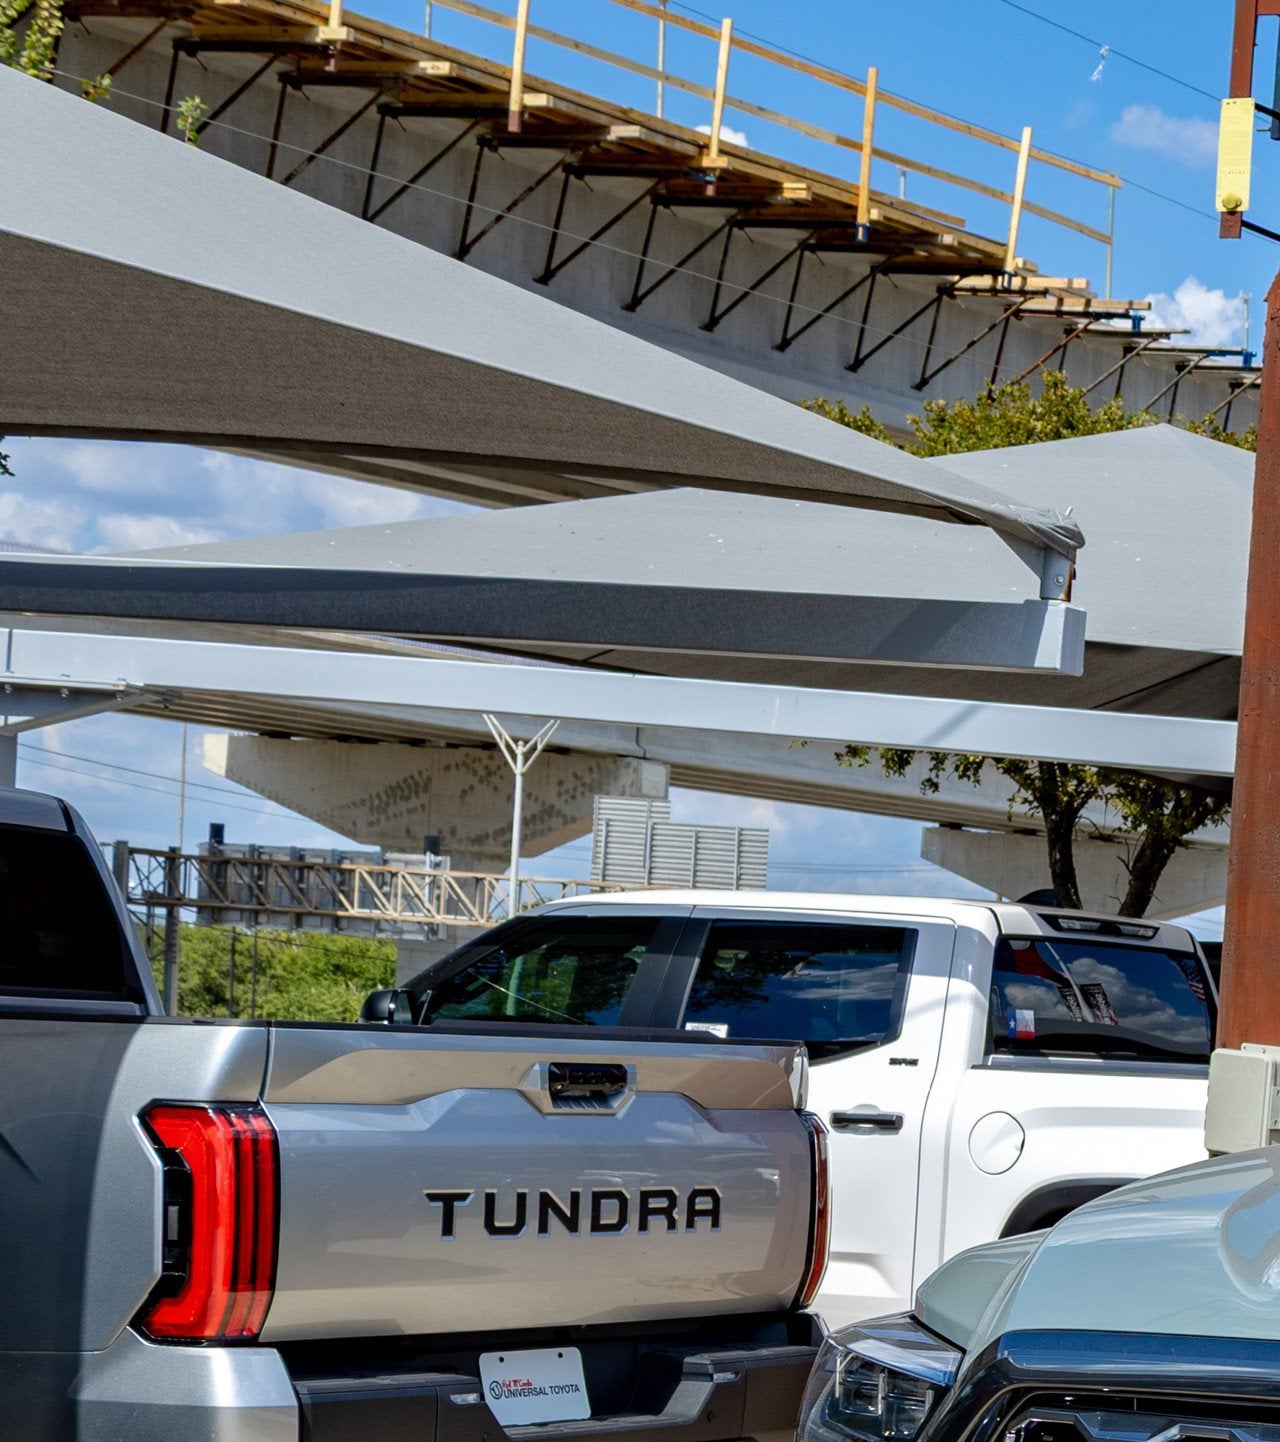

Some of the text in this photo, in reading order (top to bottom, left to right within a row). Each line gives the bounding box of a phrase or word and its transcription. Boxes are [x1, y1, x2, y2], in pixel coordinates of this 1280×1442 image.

[422, 1186, 723, 1241] TUNDRA
[504, 1384, 580, 1398] UNIVERSAL TOYOTA
